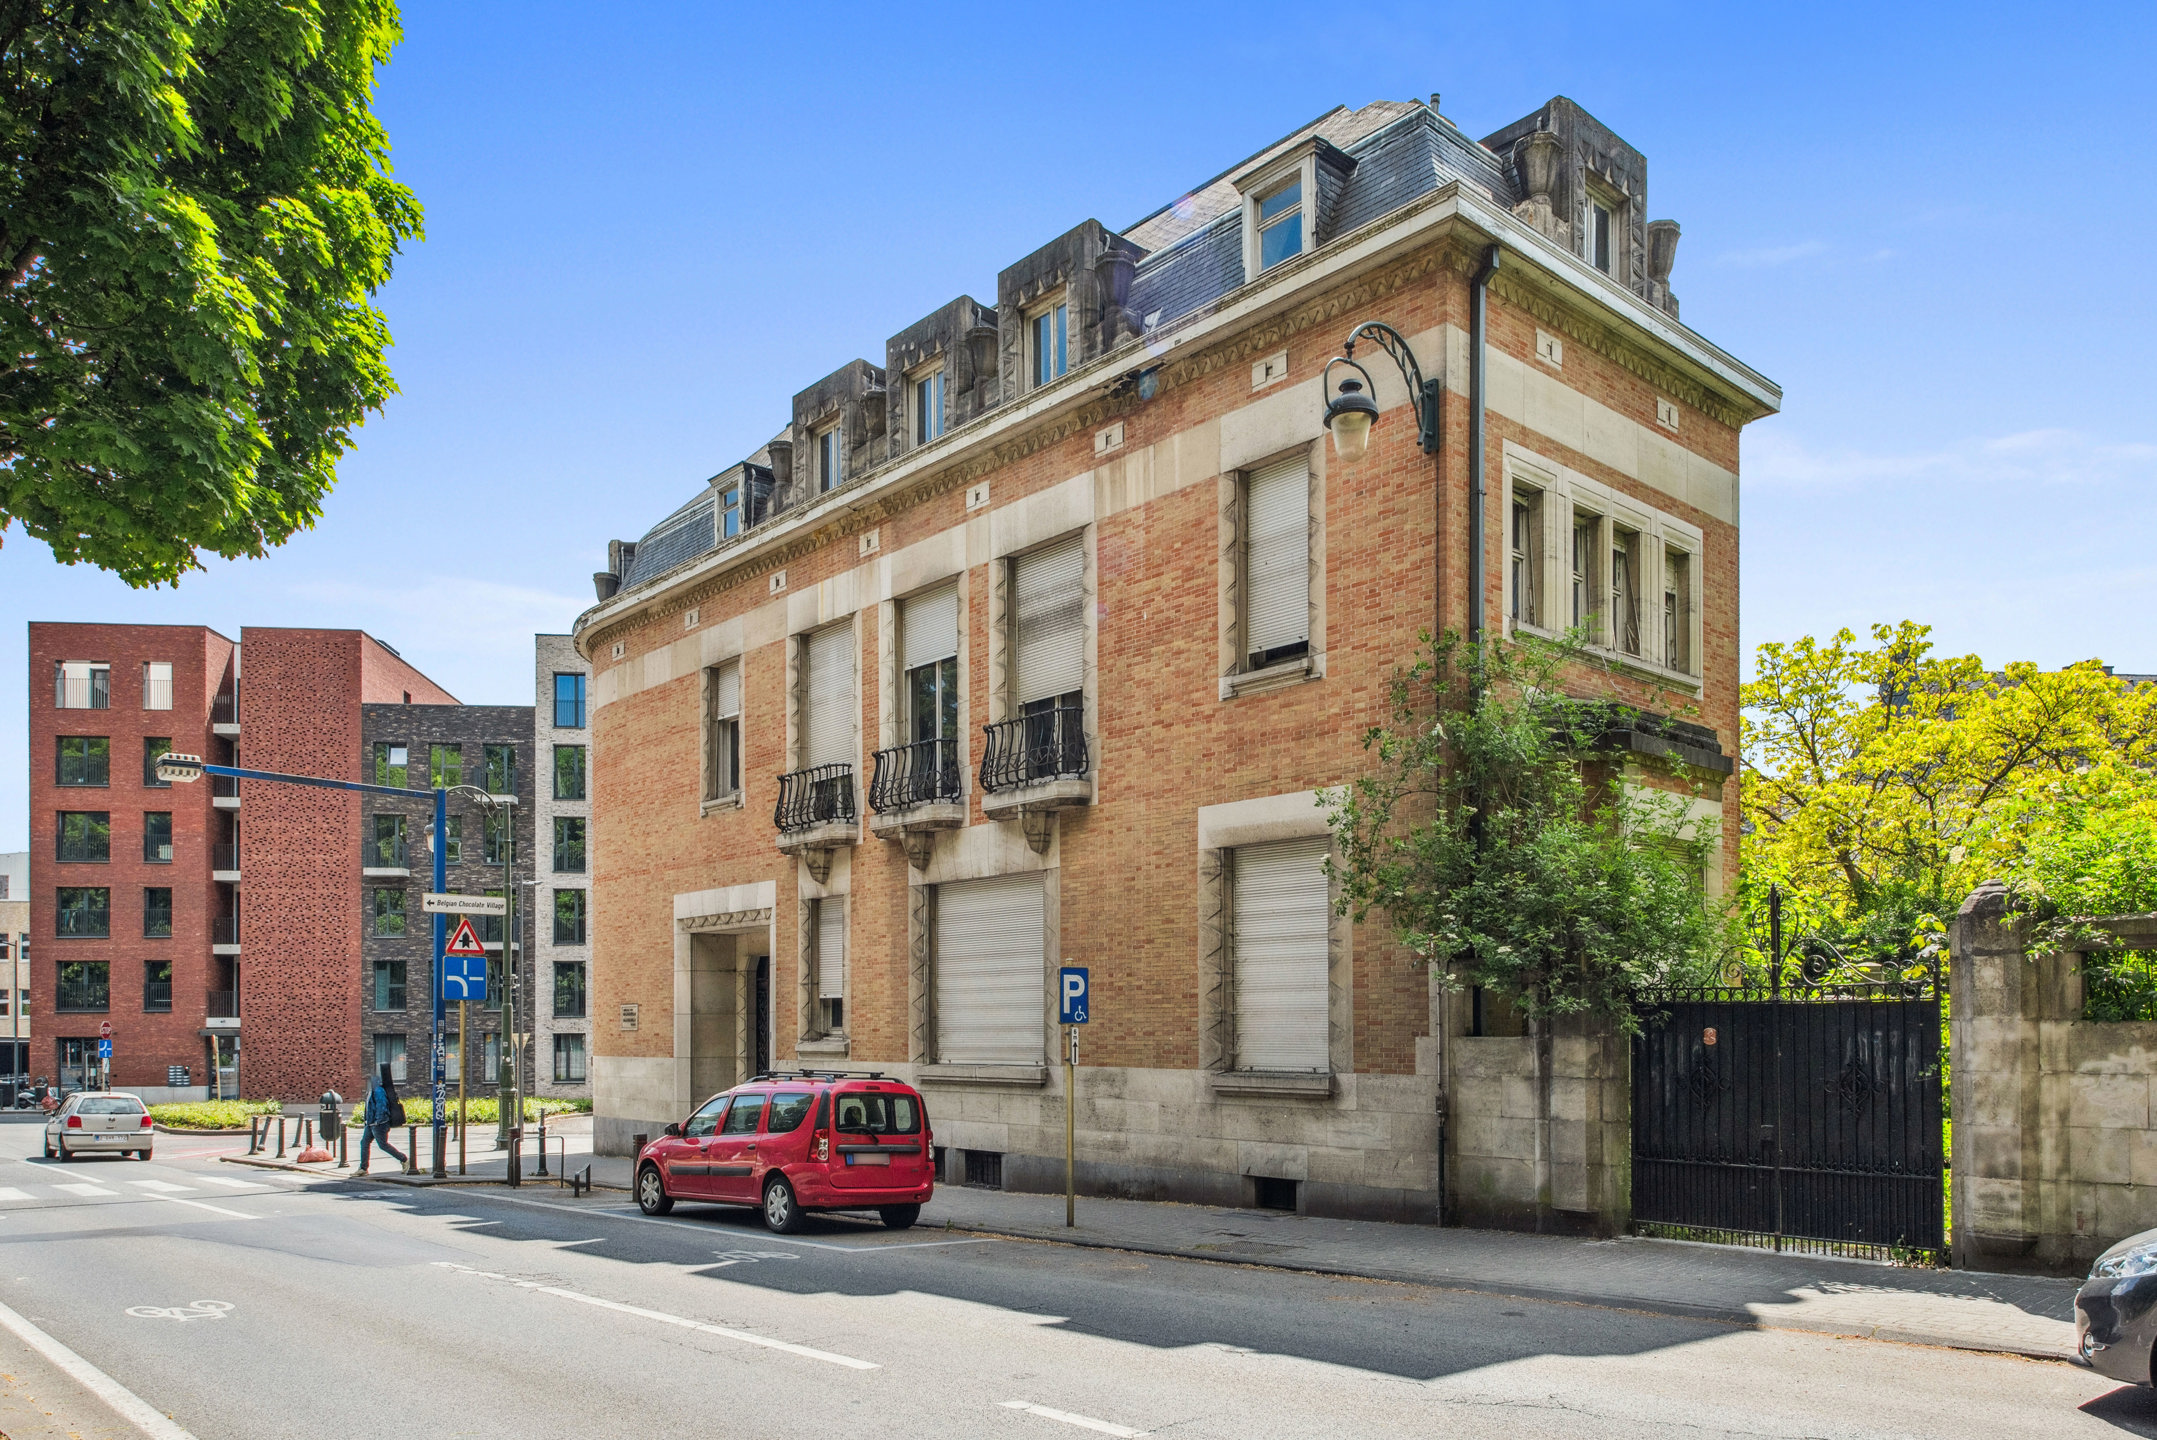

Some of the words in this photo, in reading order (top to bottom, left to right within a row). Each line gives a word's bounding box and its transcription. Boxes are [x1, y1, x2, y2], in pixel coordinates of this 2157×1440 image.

[437, 900, 457, 908] Belgian
[486, 902, 504, 910] Village
[1063, 974, 1086, 1014] P
